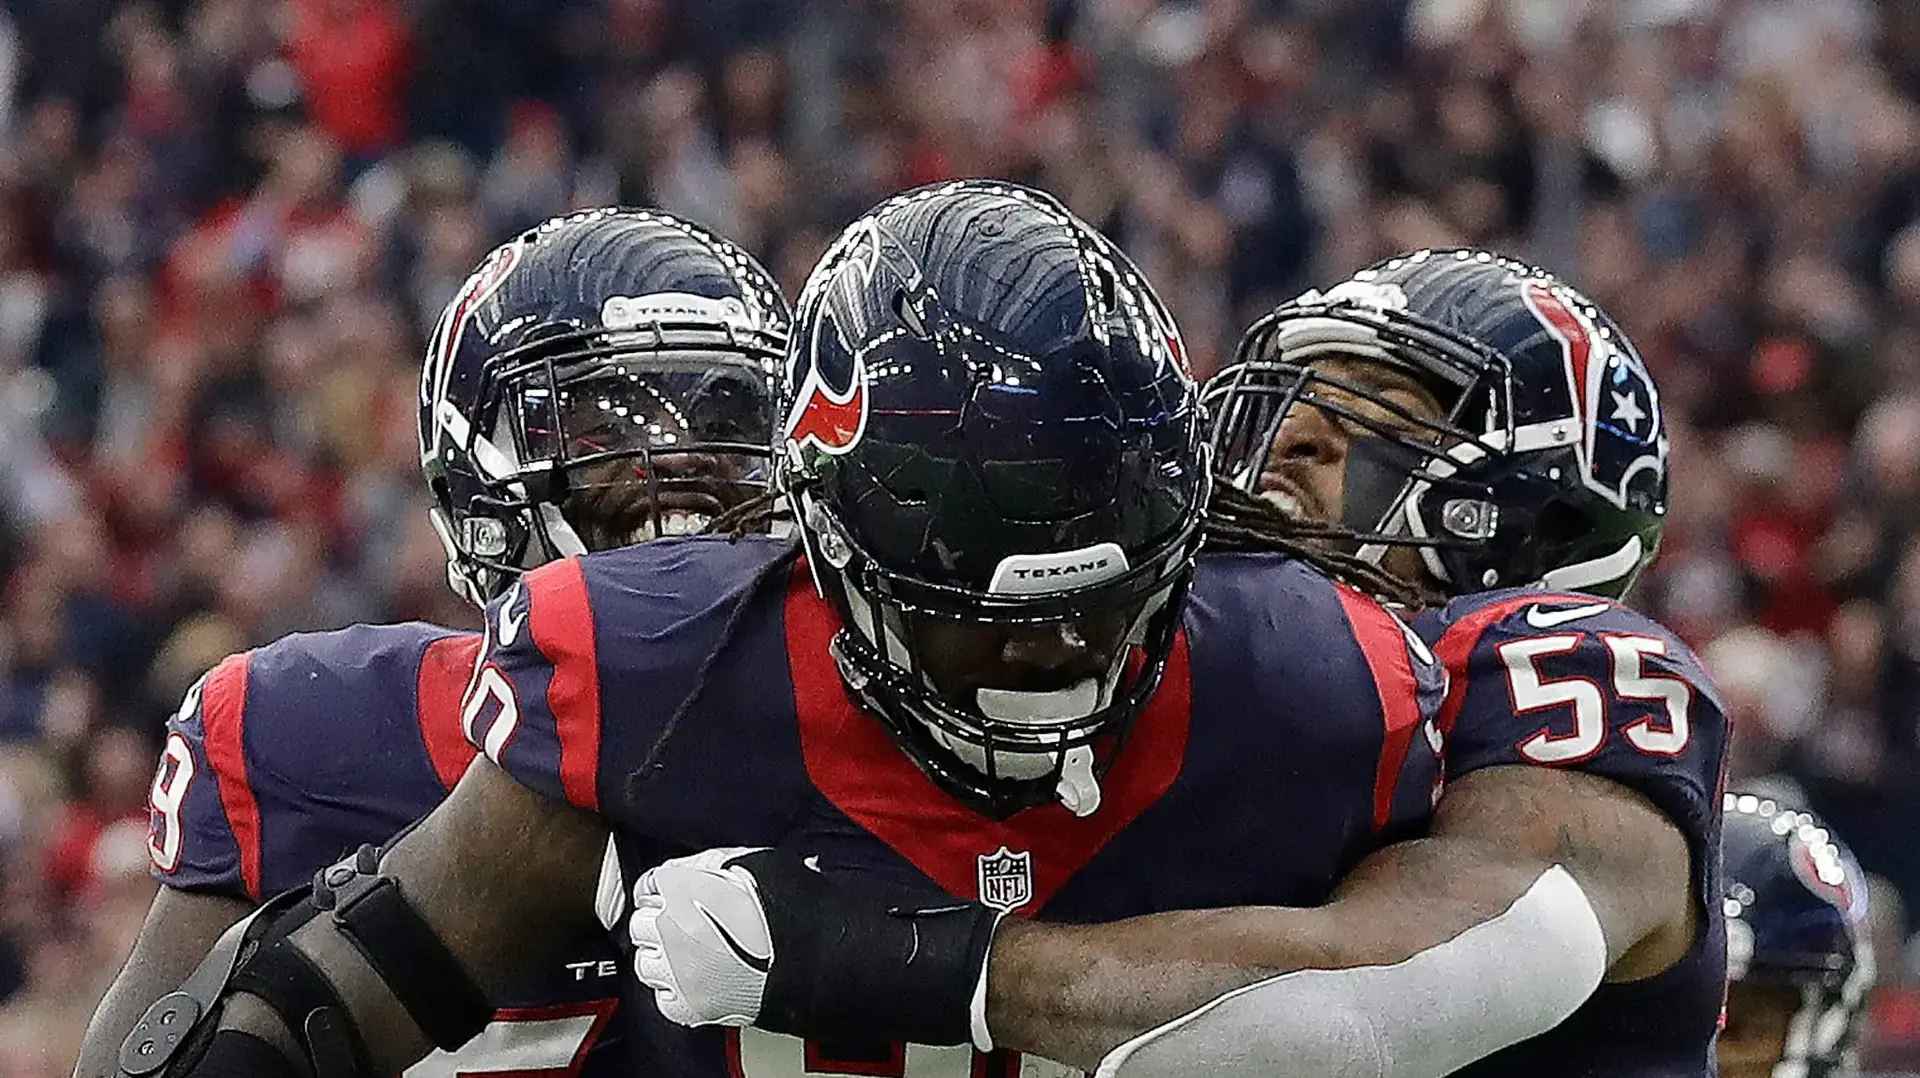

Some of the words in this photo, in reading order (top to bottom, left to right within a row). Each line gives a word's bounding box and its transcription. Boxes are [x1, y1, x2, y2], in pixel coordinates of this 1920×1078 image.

[637, 307, 708, 315] TEXANS
[1013, 559, 1108, 579] TEXANS
[1496, 633, 1694, 765] 55
[147, 731, 197, 873] 9
[987, 876, 1025, 902] NFL
